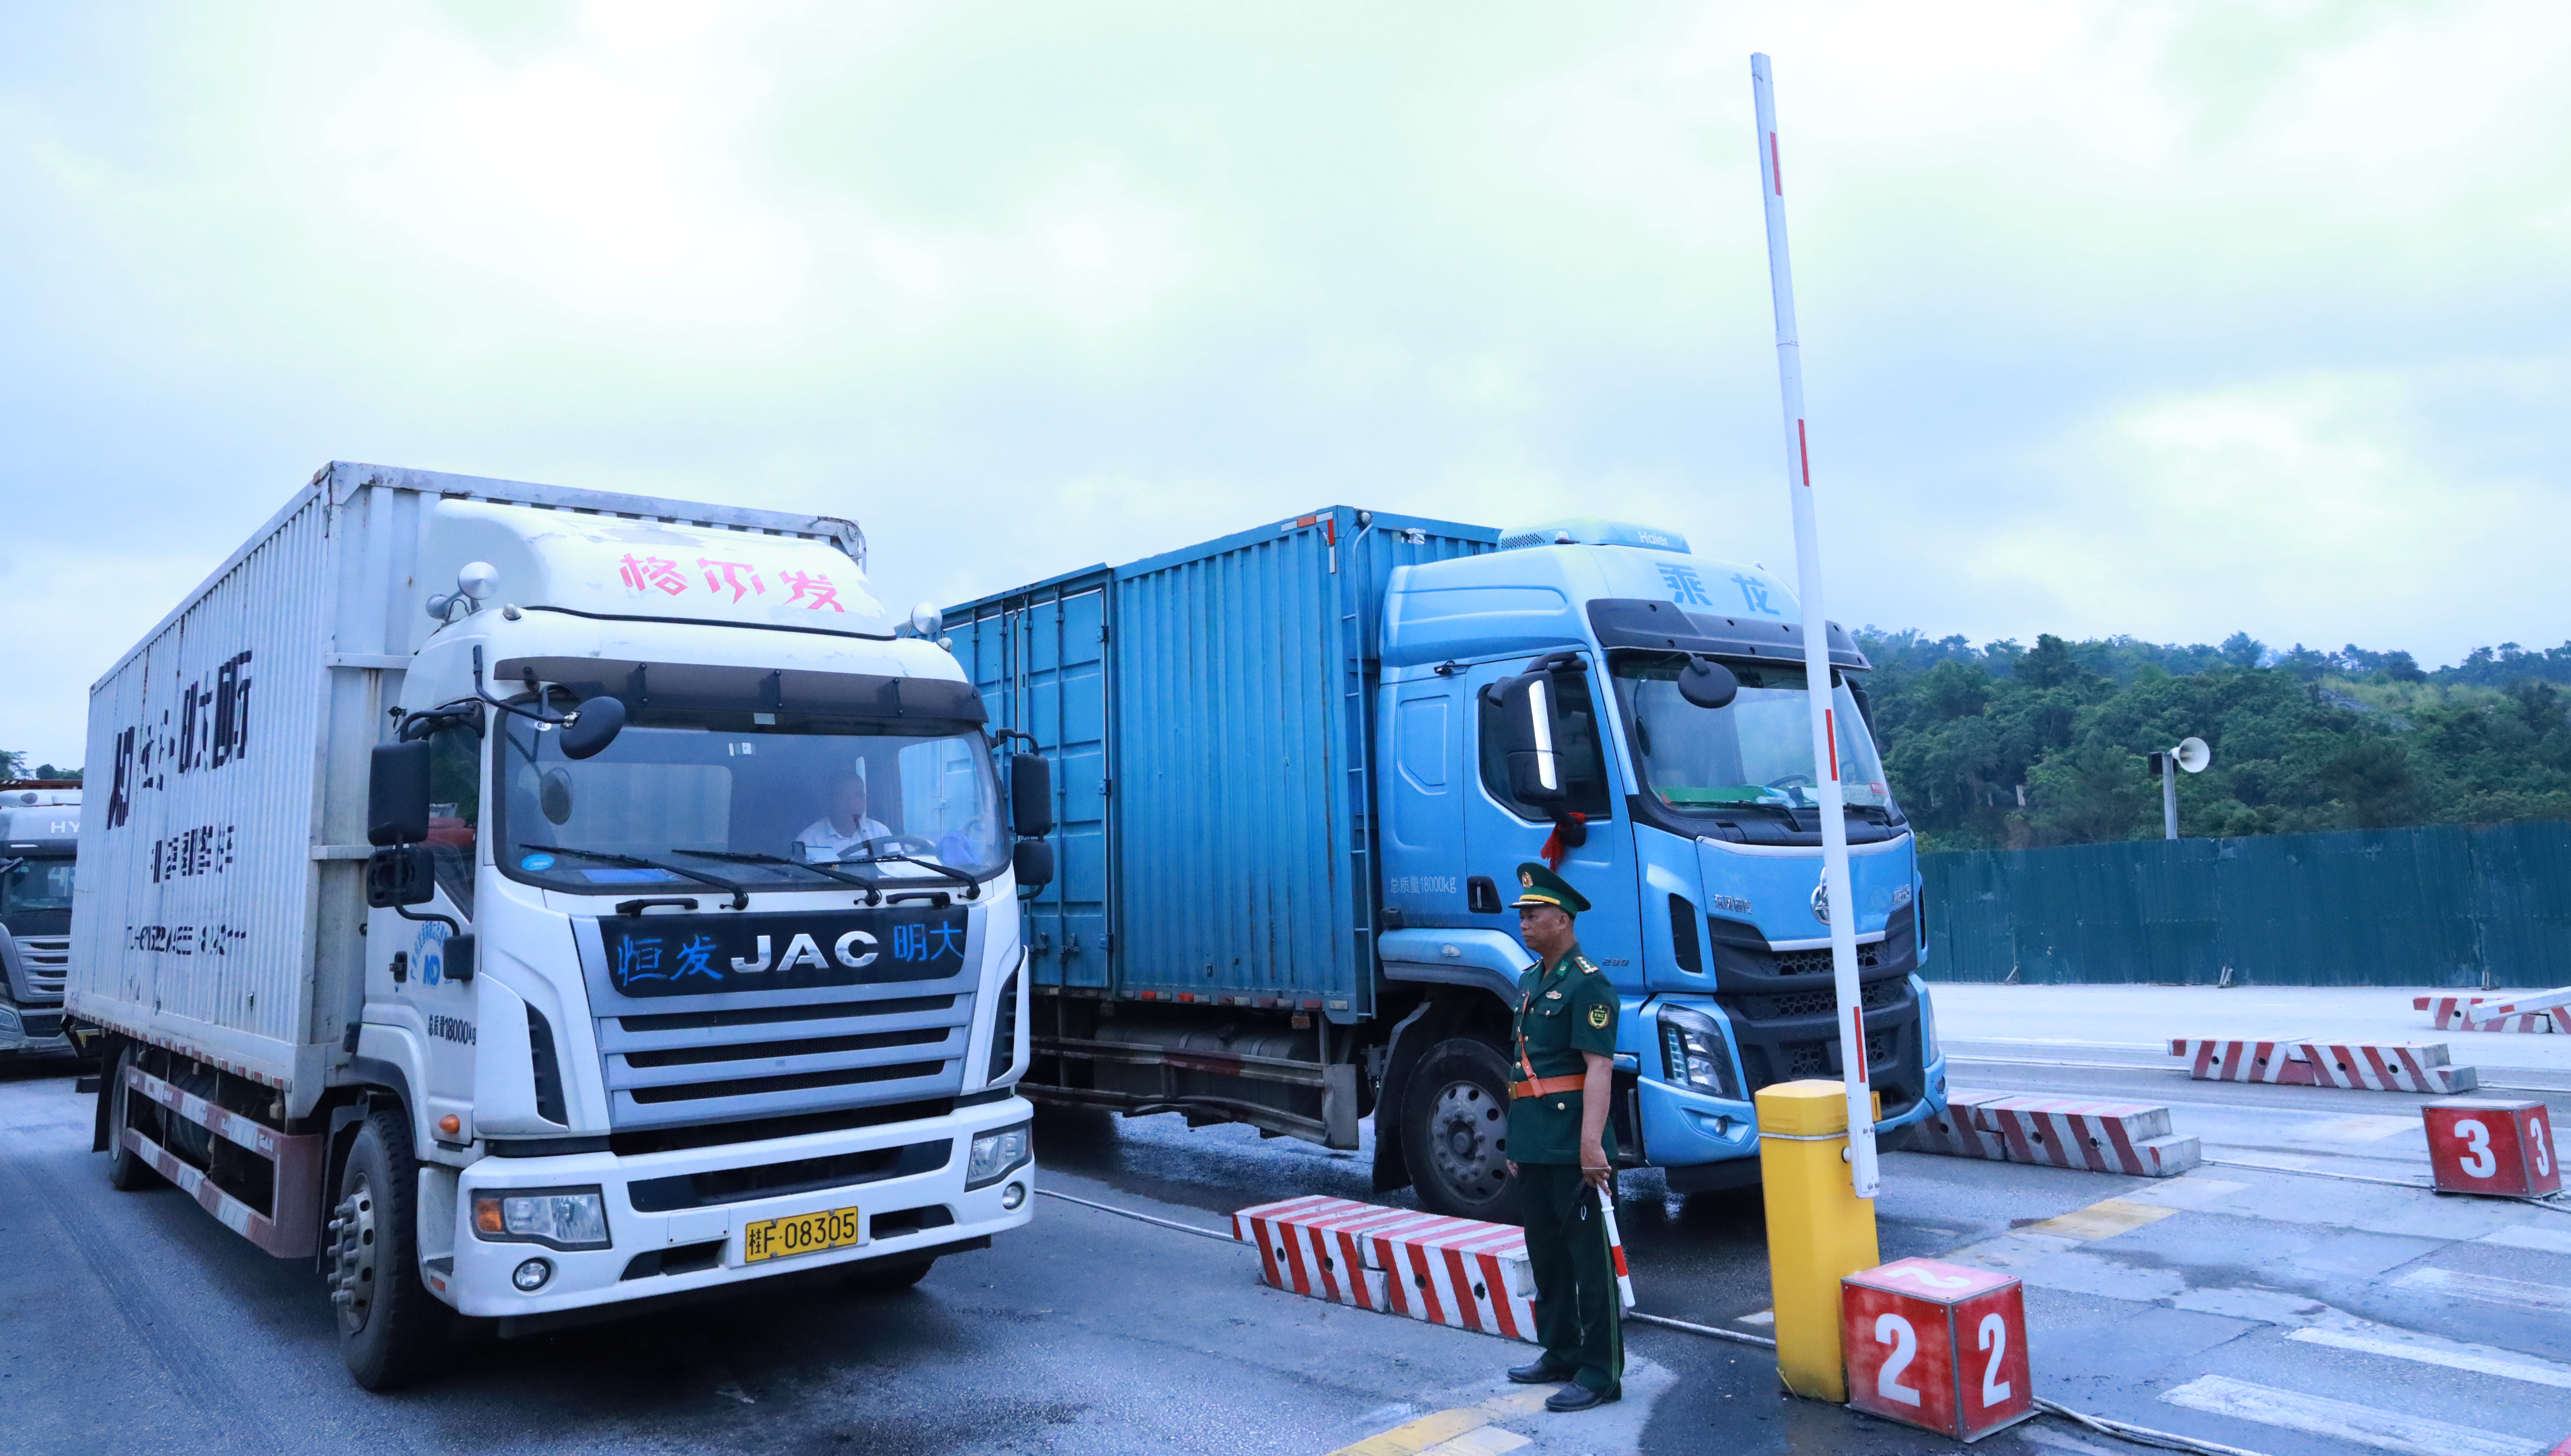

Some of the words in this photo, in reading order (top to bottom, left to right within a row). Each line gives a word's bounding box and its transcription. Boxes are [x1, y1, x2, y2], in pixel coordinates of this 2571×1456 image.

[1638, 531, 1669, 547] Haier
[1655, 562, 1780, 615] 乘龙
[617, 935, 724, 986] 恒发
[731, 931, 879, 973] JAC
[893, 920, 964, 962] 明大
[1602, 958, 1629, 966] 290
[428, 1014, 476, 1046] 总质量18000kg
[2455, 1119, 2497, 1178] 3
[2530, 1117, 2550, 1177] 3
[1875, 1313, 1921, 1407] 2
[1978, 1313, 2011, 1408] 2
